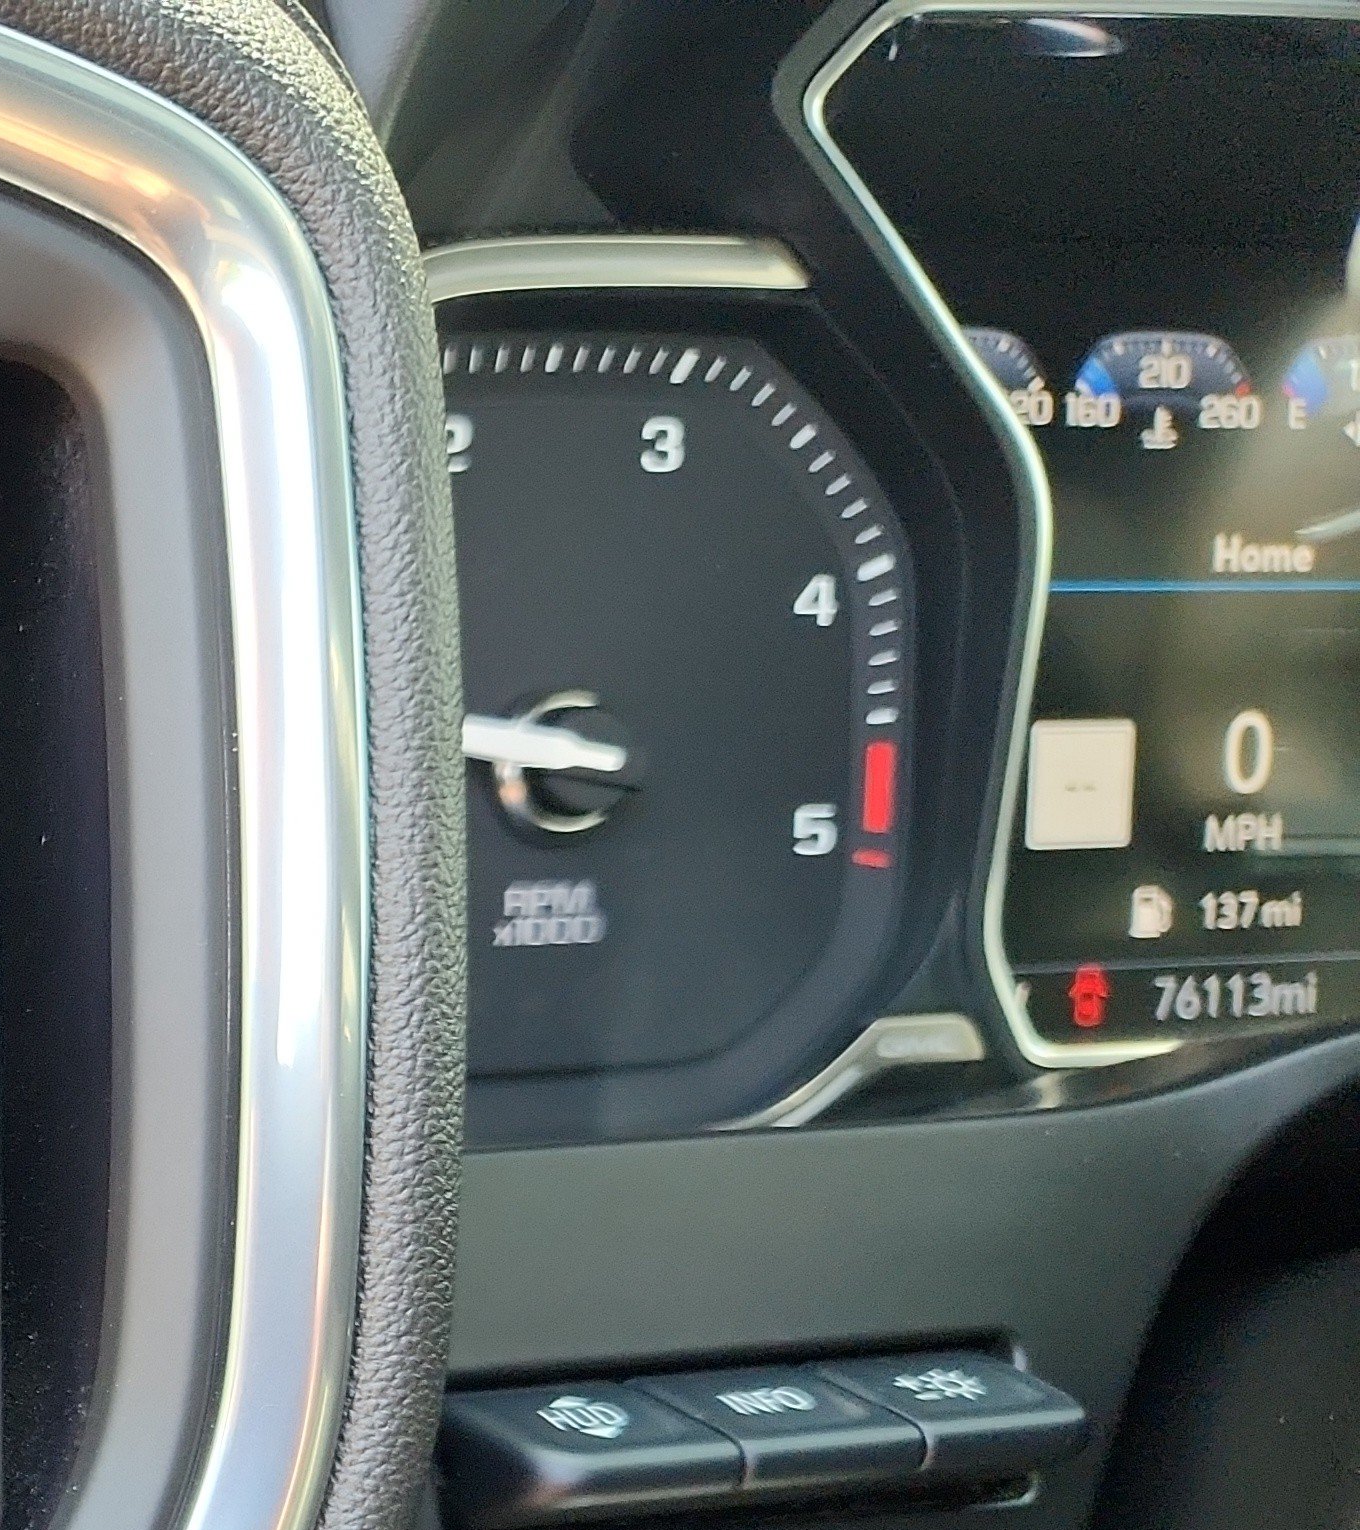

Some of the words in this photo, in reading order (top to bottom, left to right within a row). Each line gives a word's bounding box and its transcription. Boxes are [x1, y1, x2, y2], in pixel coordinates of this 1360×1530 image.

[1138, 353, 1193, 389] 210
[1065, 392, 1122, 428] 160
[1198, 393, 1262, 430] 260
[1288, 400, 1308, 430] E
[640, 415, 685, 473] 3
[1210, 531, 1317, 574] Home
[793, 573, 840, 627] 4
[1224, 708, 1276, 795] 0
[792, 803, 839, 856] 5
[1202, 811, 1284, 853] MPH
[535, 1400, 630, 1433] HUD
[715, 1385, 817, 1417] INFO
